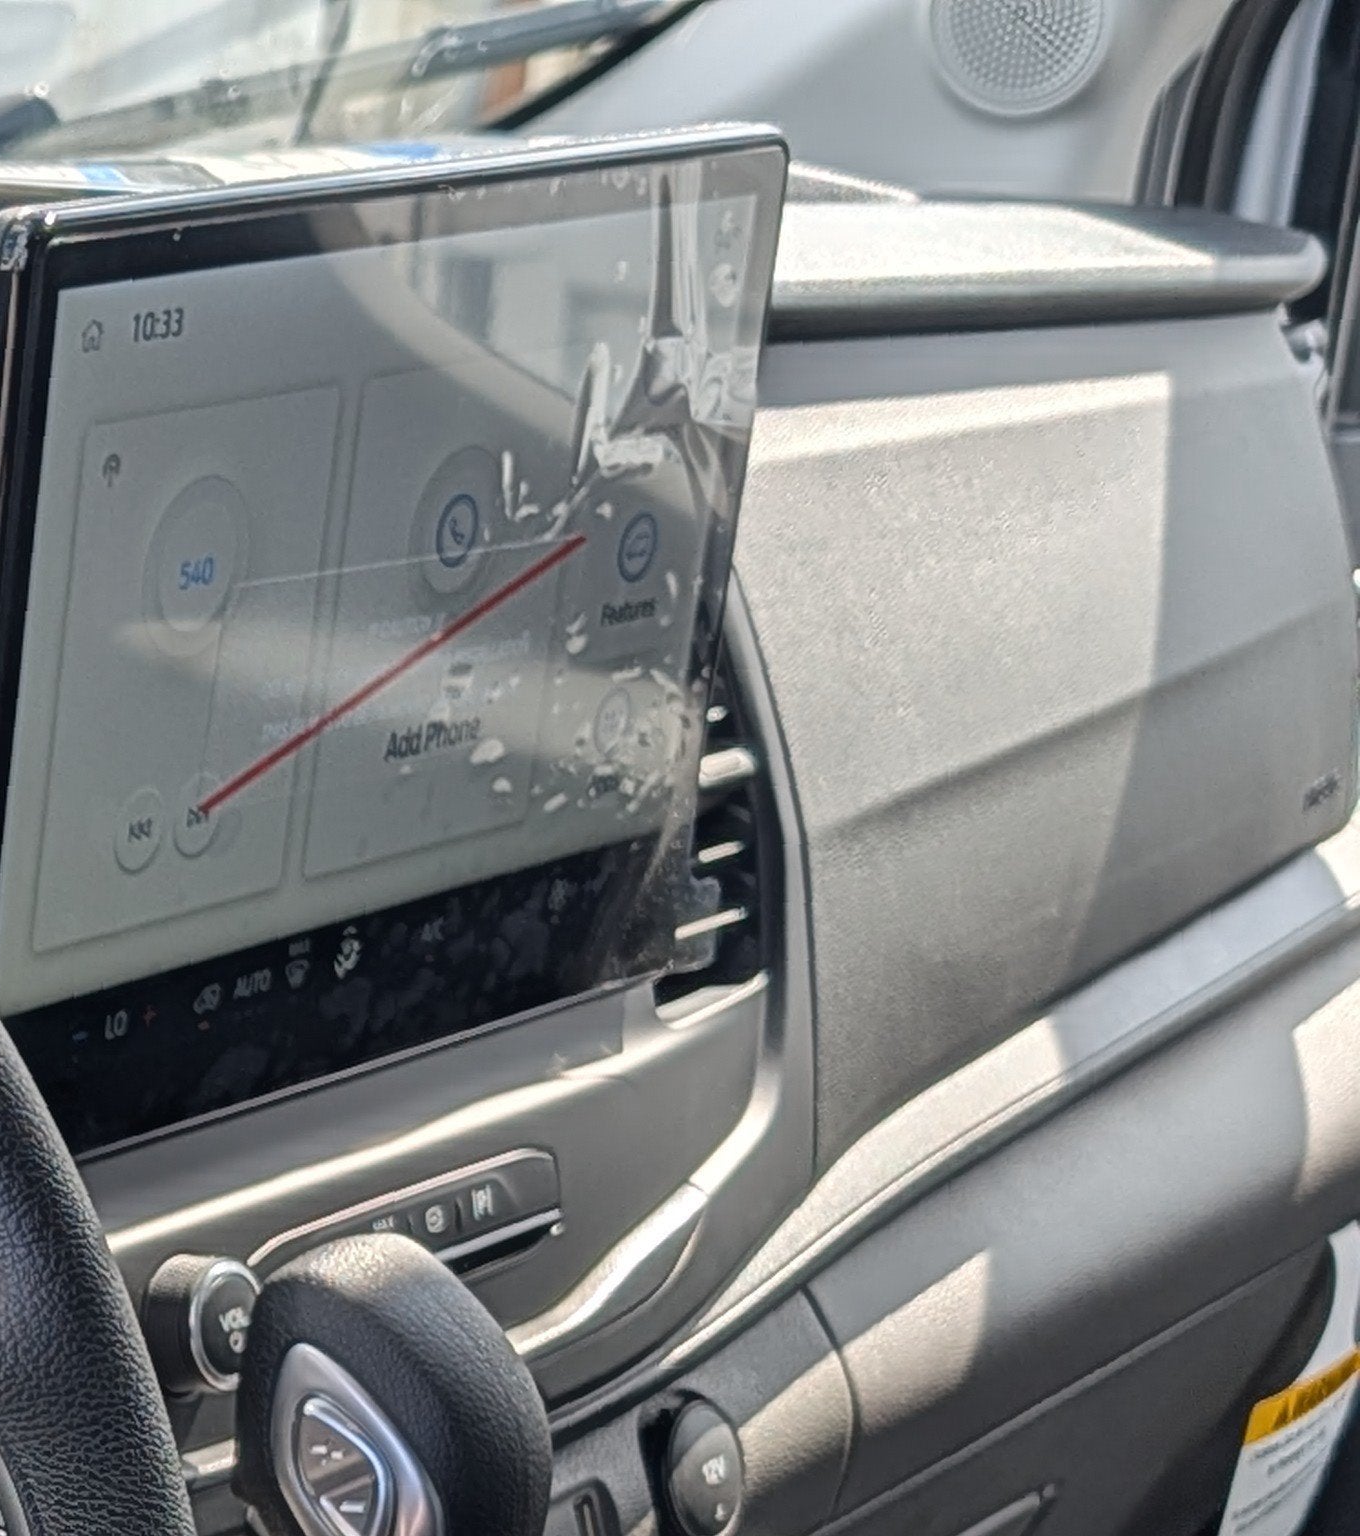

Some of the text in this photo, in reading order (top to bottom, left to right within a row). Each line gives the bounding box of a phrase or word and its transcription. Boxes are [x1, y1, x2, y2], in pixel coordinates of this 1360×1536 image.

[132, 307, 184, 342] 10:33
[179, 558, 214, 591] 540
[600, 598, 656, 627] Features
[384, 724, 422, 762] Add
[425, 717, 480, 751] Phone
[233, 969, 272, 1000] AUTO
[104, 1009, 128, 1041] LO
[219, 1306, 250, 1332] VOL
